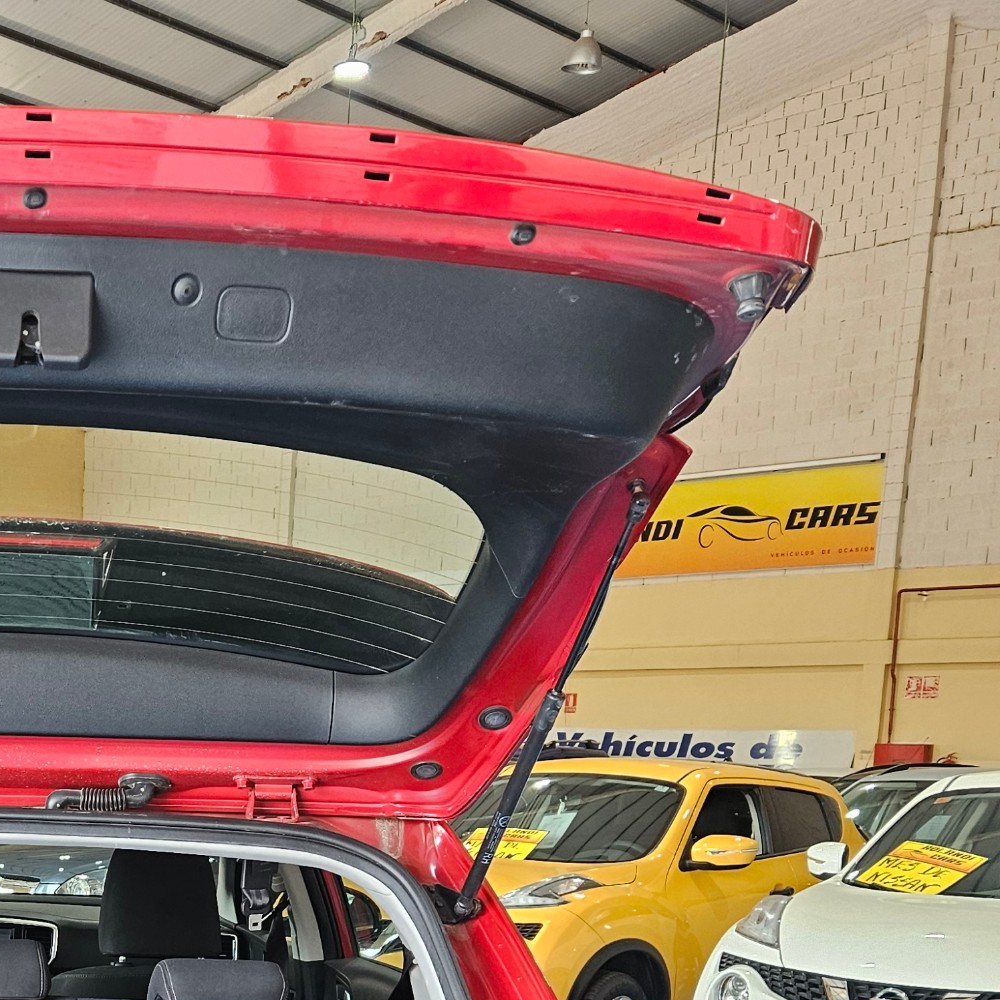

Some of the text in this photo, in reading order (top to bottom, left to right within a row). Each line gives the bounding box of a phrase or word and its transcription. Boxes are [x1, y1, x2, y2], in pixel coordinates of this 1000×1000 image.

[785, 501, 882, 531] CARS
[879, 857, 950, 879] MES DE
[929, 854, 966, 866] CARS
